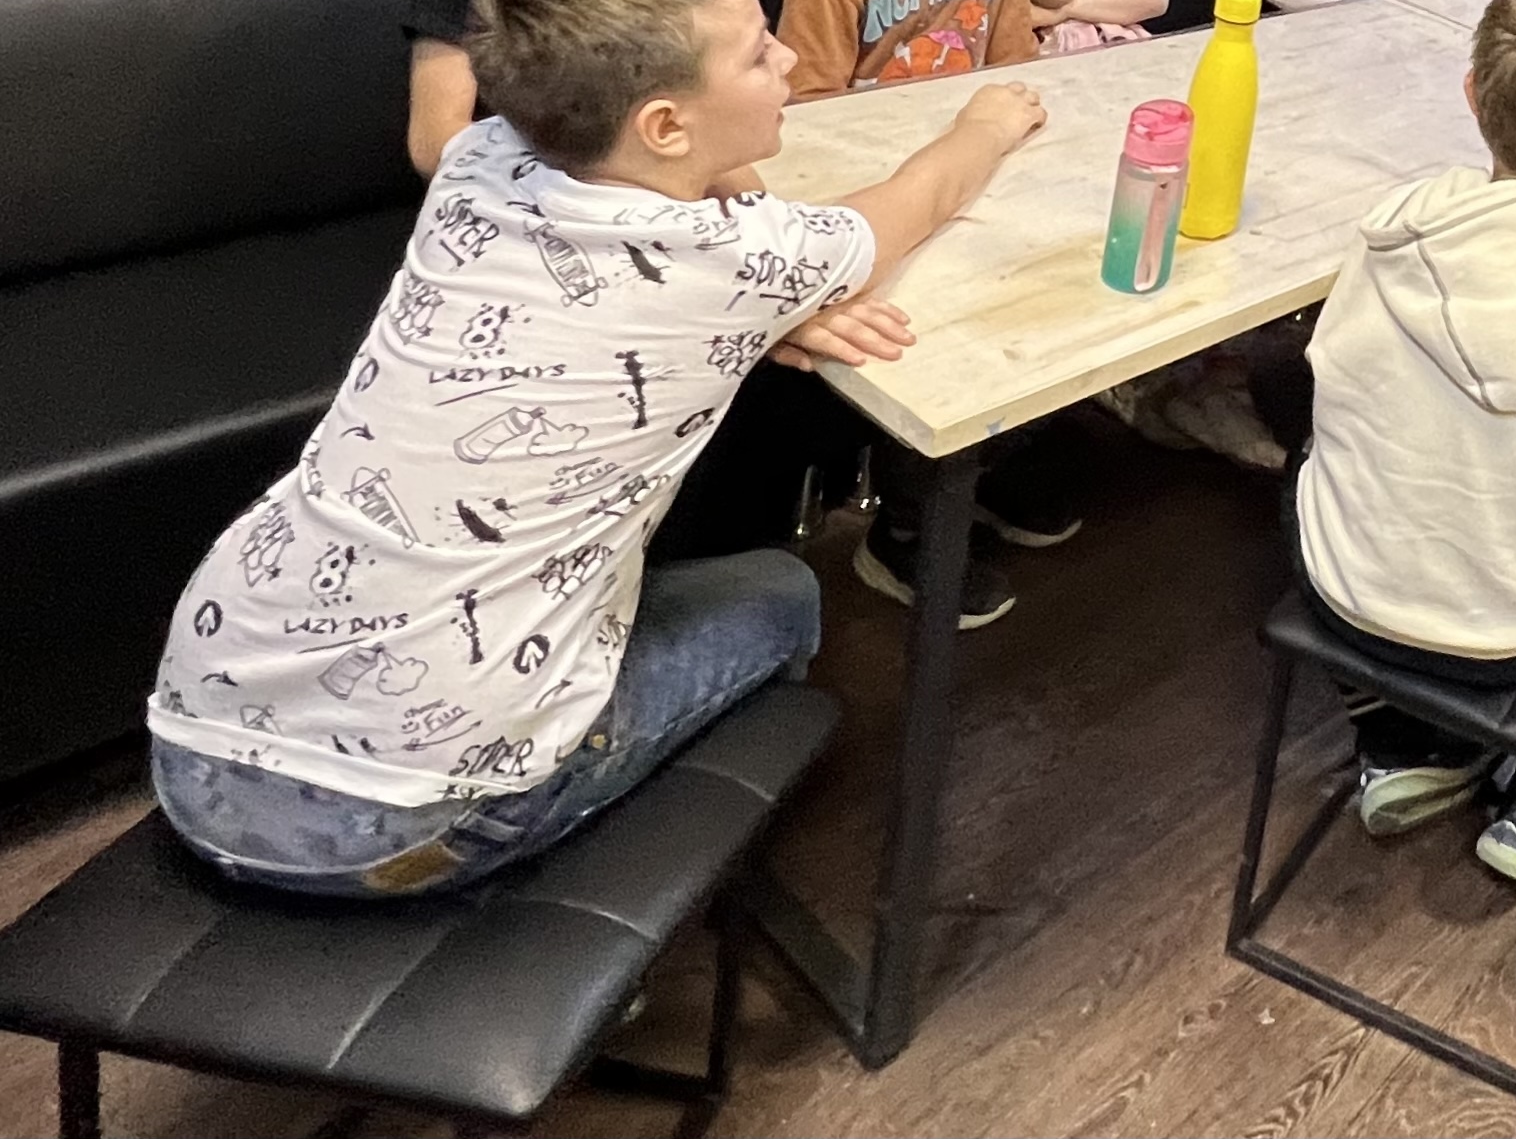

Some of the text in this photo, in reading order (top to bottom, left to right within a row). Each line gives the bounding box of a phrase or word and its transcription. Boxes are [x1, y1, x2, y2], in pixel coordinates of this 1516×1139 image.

[428, 365, 495, 384] LAZY
[283, 612, 409, 635] LAZY DAYS
